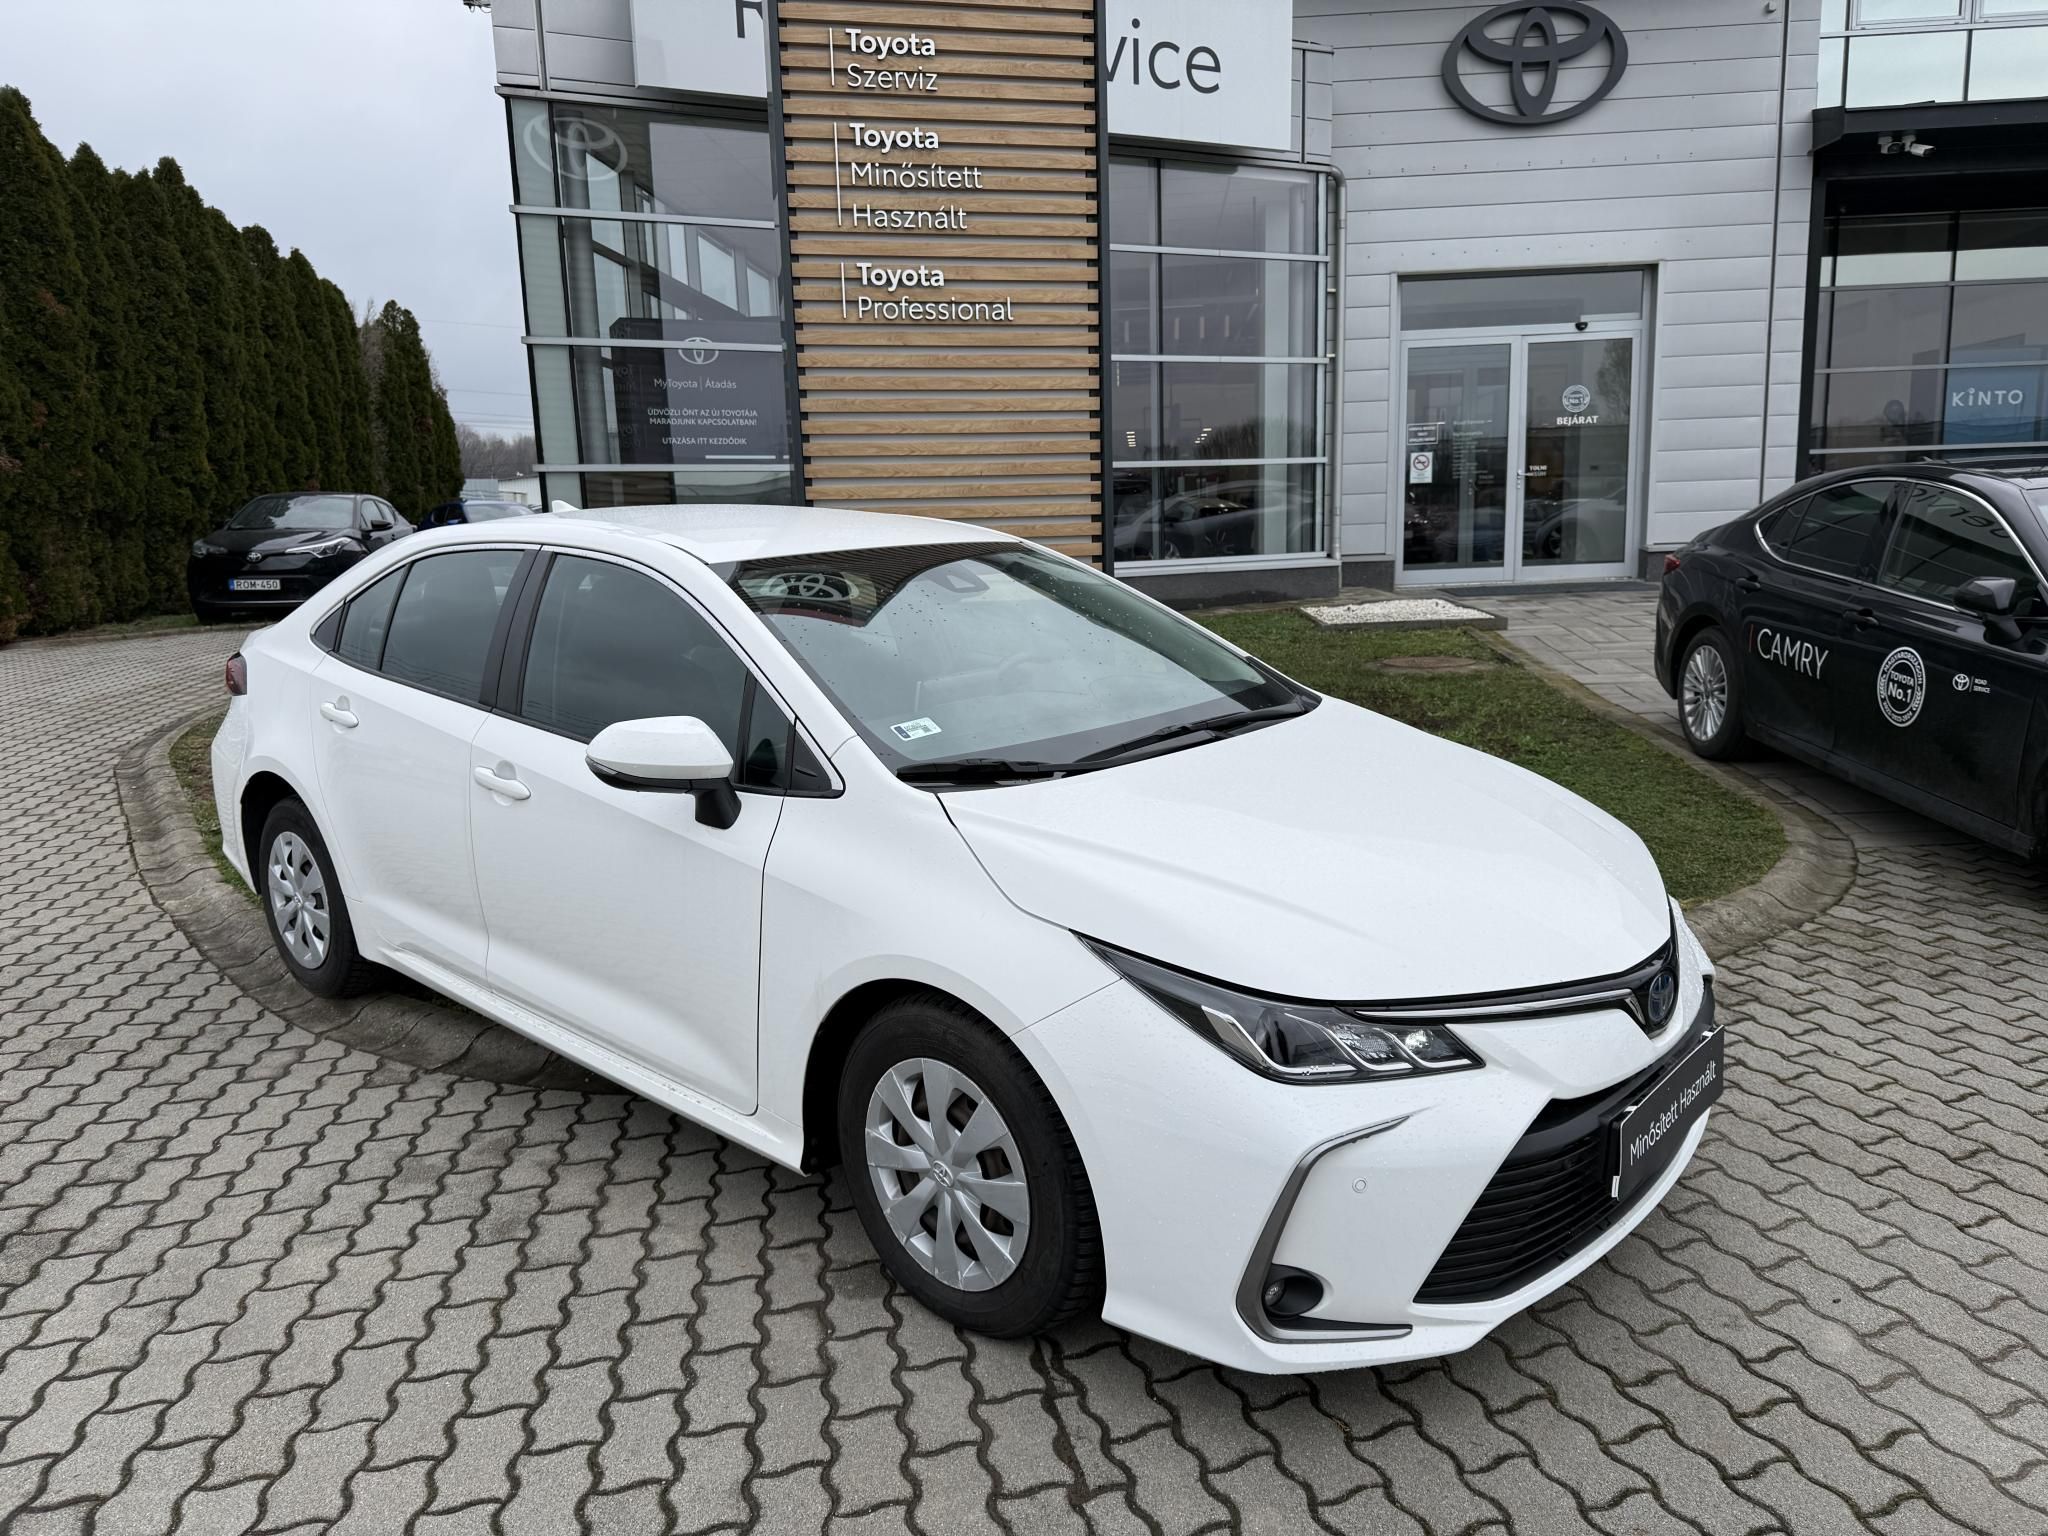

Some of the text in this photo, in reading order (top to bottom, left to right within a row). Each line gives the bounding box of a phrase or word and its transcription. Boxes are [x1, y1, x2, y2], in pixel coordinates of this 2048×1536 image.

[845, 28, 936, 60] Toyota
[847, 63, 938, 91] Szerviz
[849, 122, 939, 154] Toyota
[851, 162, 983, 189] Minősített
[853, 203, 968, 230] Használt
[856, 262, 945, 292] Toyota
[858, 296, 1014, 321] Professional
[654, 378, 737, 390] MyToyota Átadás
[1556, 414, 1599, 426] BEJÁRAT
[1757, 628, 1829, 680] CAMRY
[1890, 670, 1915, 687] TOYOTA
[1887, 681, 1912, 704] No.1
[1630, 1060, 1716, 1166] Minősített Használt
